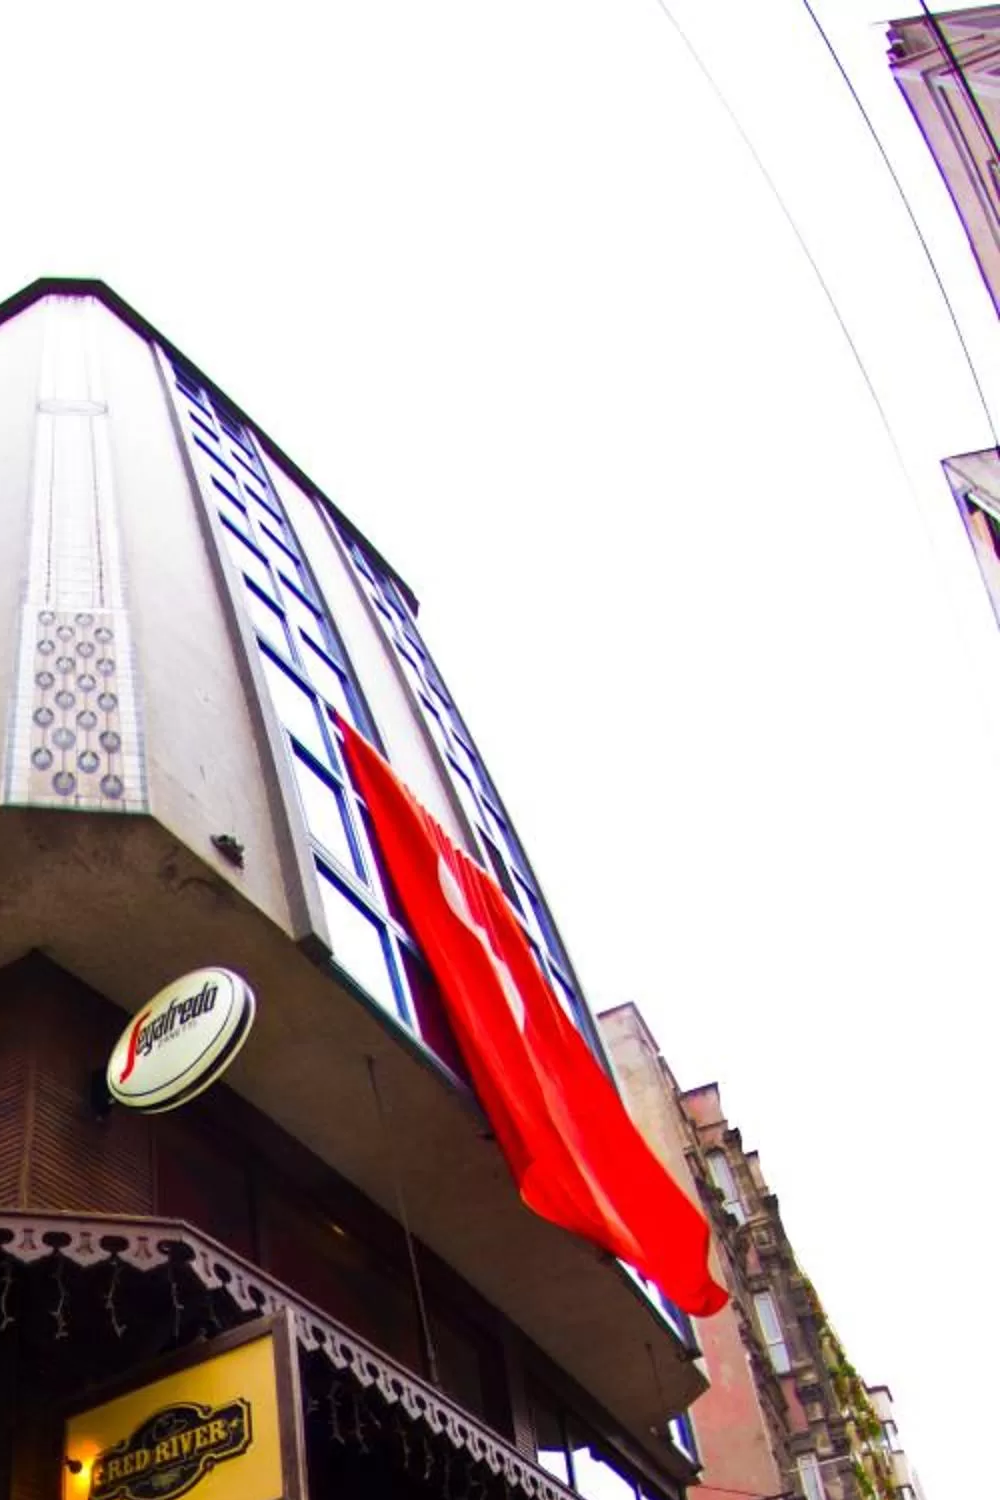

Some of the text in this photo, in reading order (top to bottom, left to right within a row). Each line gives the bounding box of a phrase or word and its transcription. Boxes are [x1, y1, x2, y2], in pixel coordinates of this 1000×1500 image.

[120, 981, 218, 1083] Segafredo
[108, 1419, 229, 1478] RED RIVER
